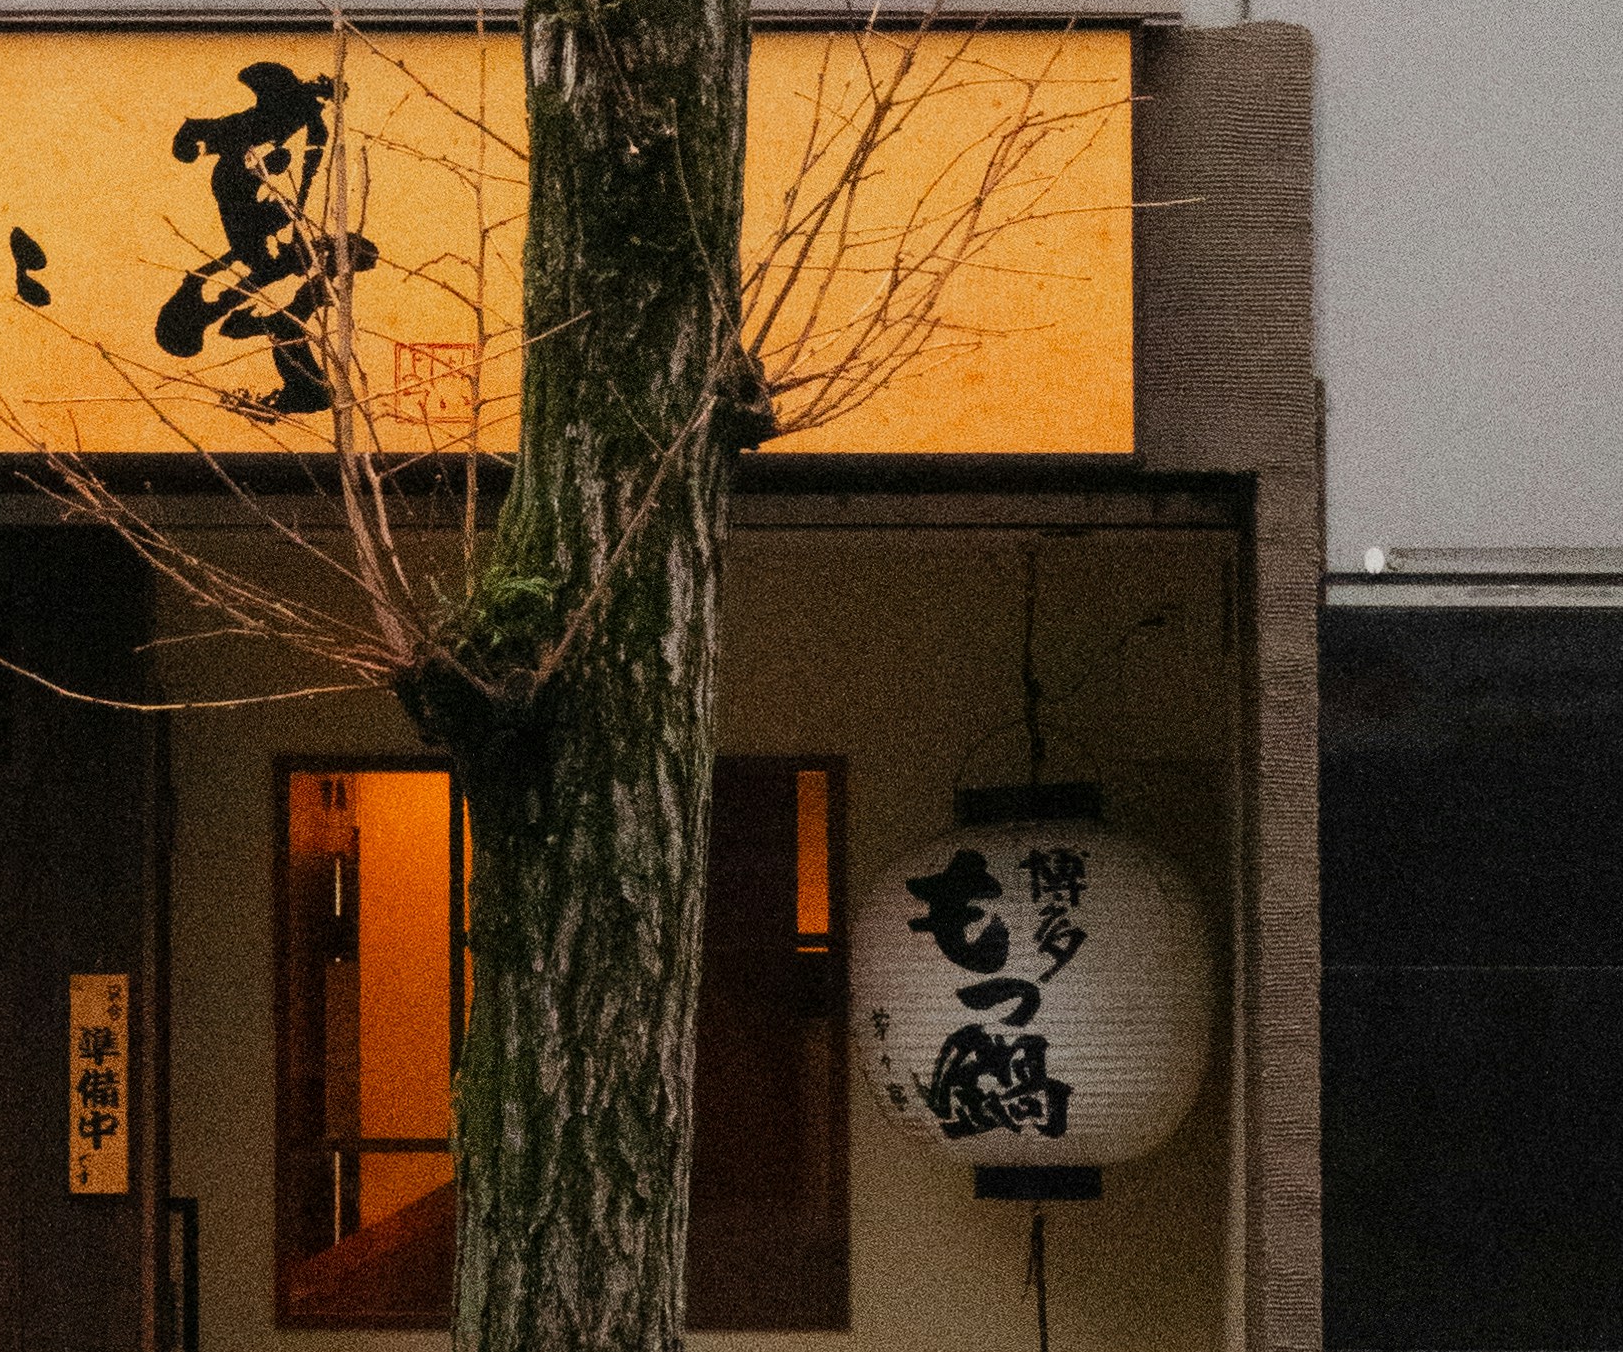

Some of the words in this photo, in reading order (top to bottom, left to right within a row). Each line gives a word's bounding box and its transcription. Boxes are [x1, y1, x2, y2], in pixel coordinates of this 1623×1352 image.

[1020, 849, 1088, 983] 博多
[906, 849, 1074, 1139] もつ鍋
[76, 1026, 120, 1150] 準備中
